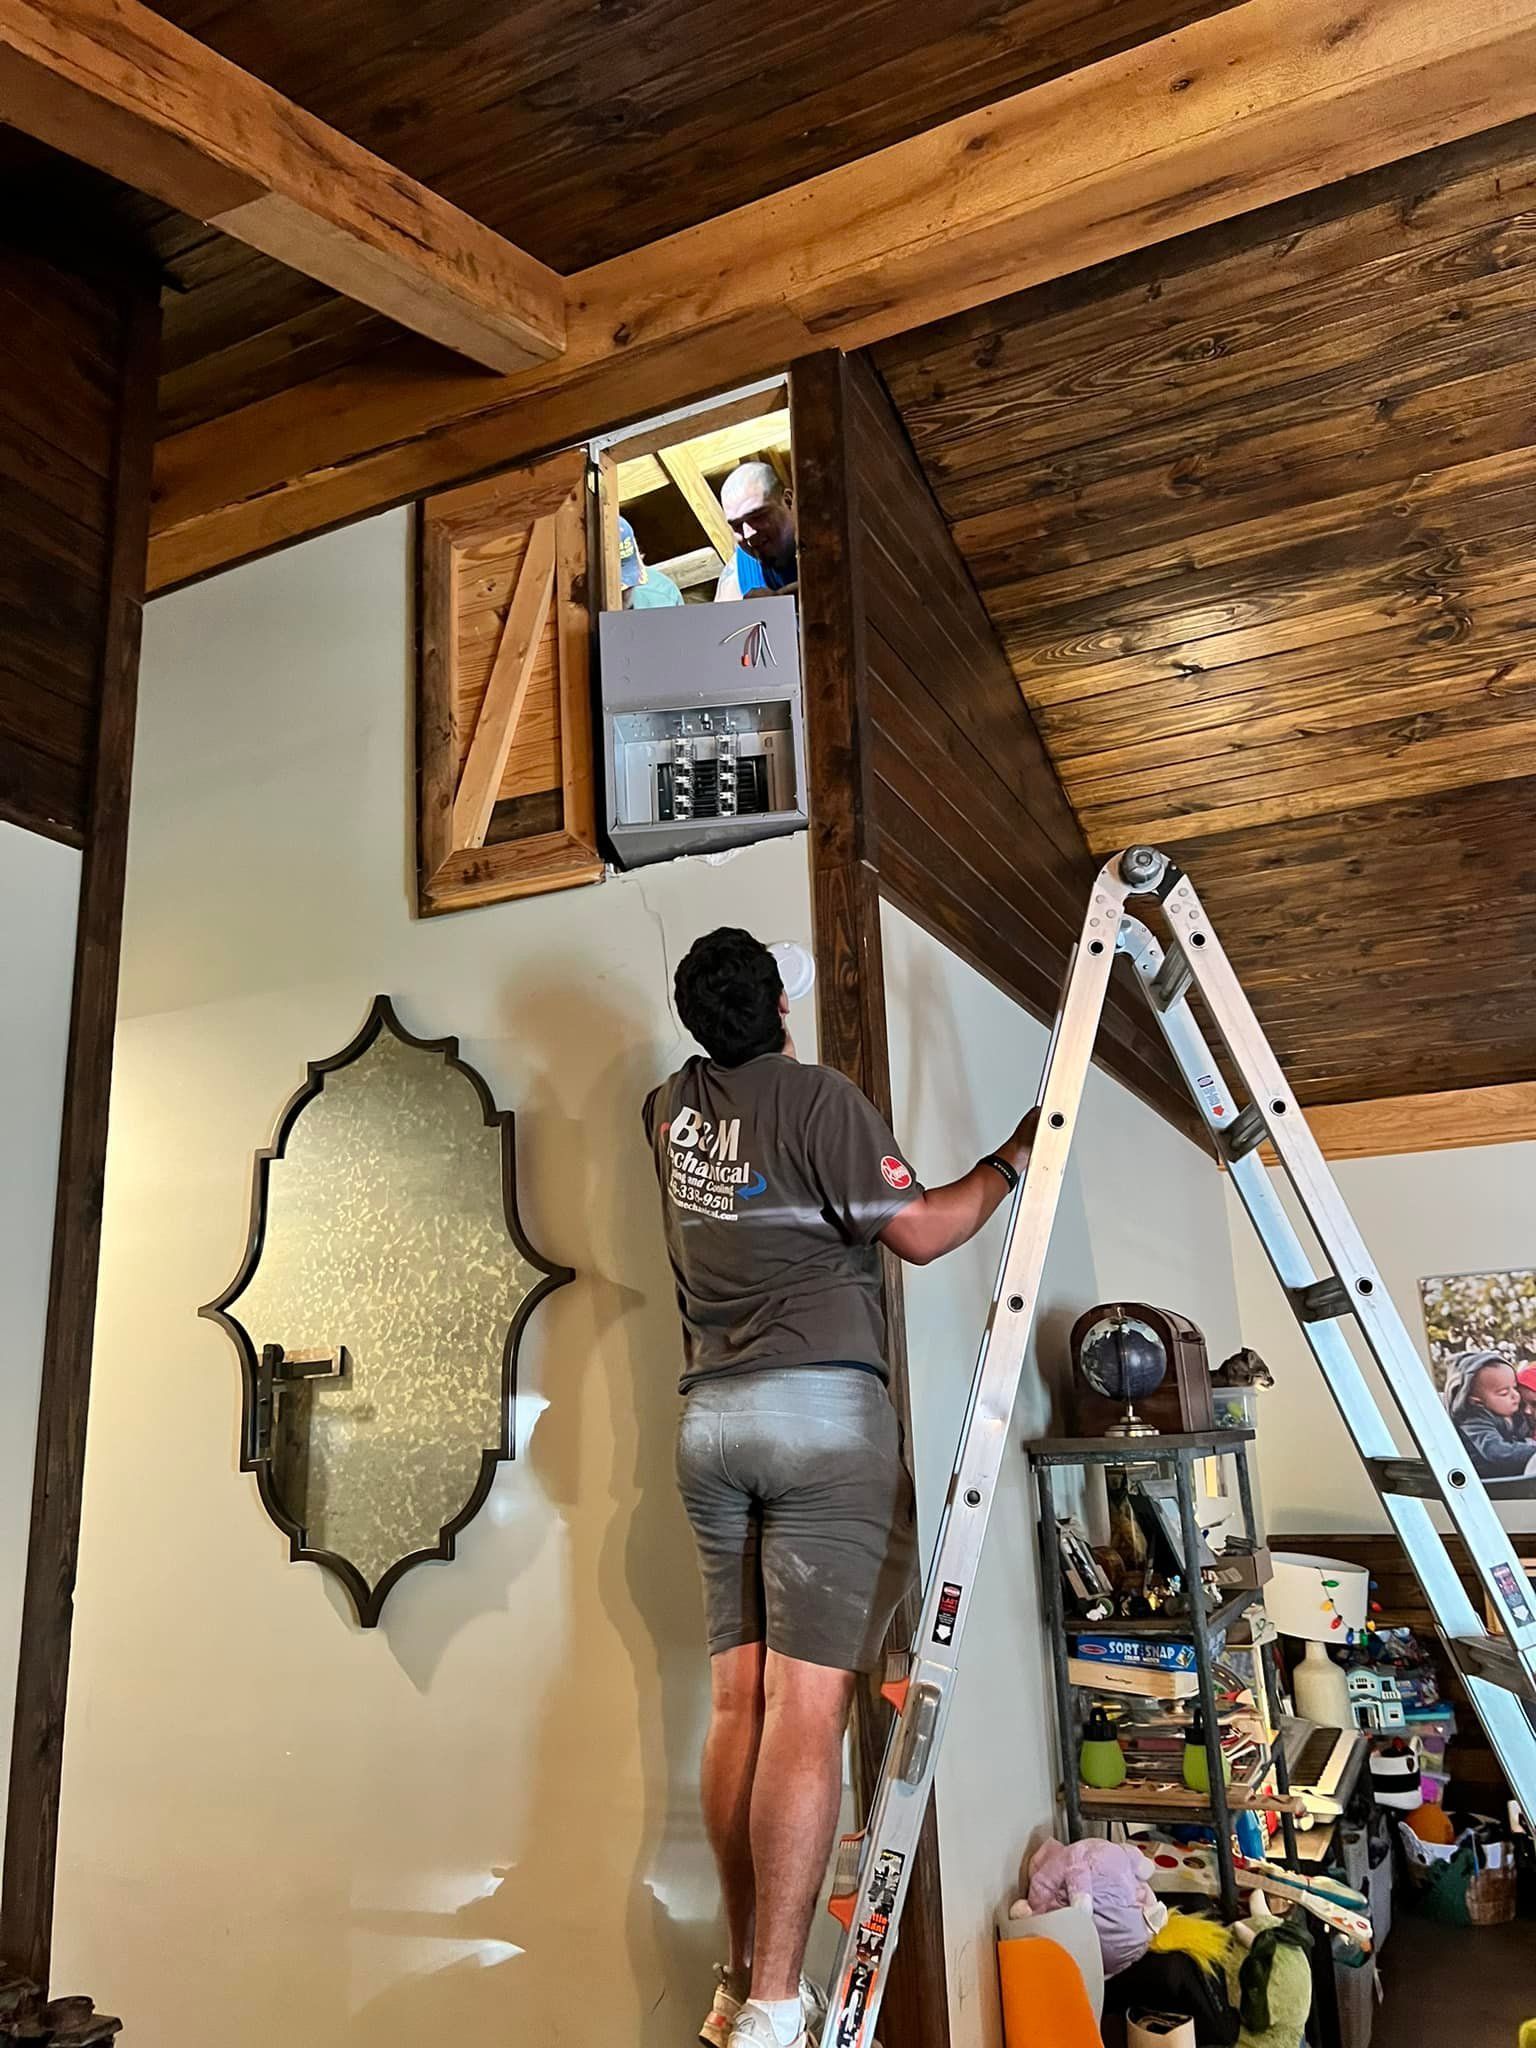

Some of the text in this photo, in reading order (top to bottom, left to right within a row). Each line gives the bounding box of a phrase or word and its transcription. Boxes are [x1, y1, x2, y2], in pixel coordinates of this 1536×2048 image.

[670, 1106, 741, 1161] B&M
[668, 1149, 750, 1184] chanical
[1108, 1640, 1139, 1656] SORT
[1146, 1643, 1175, 1660] SNAP
